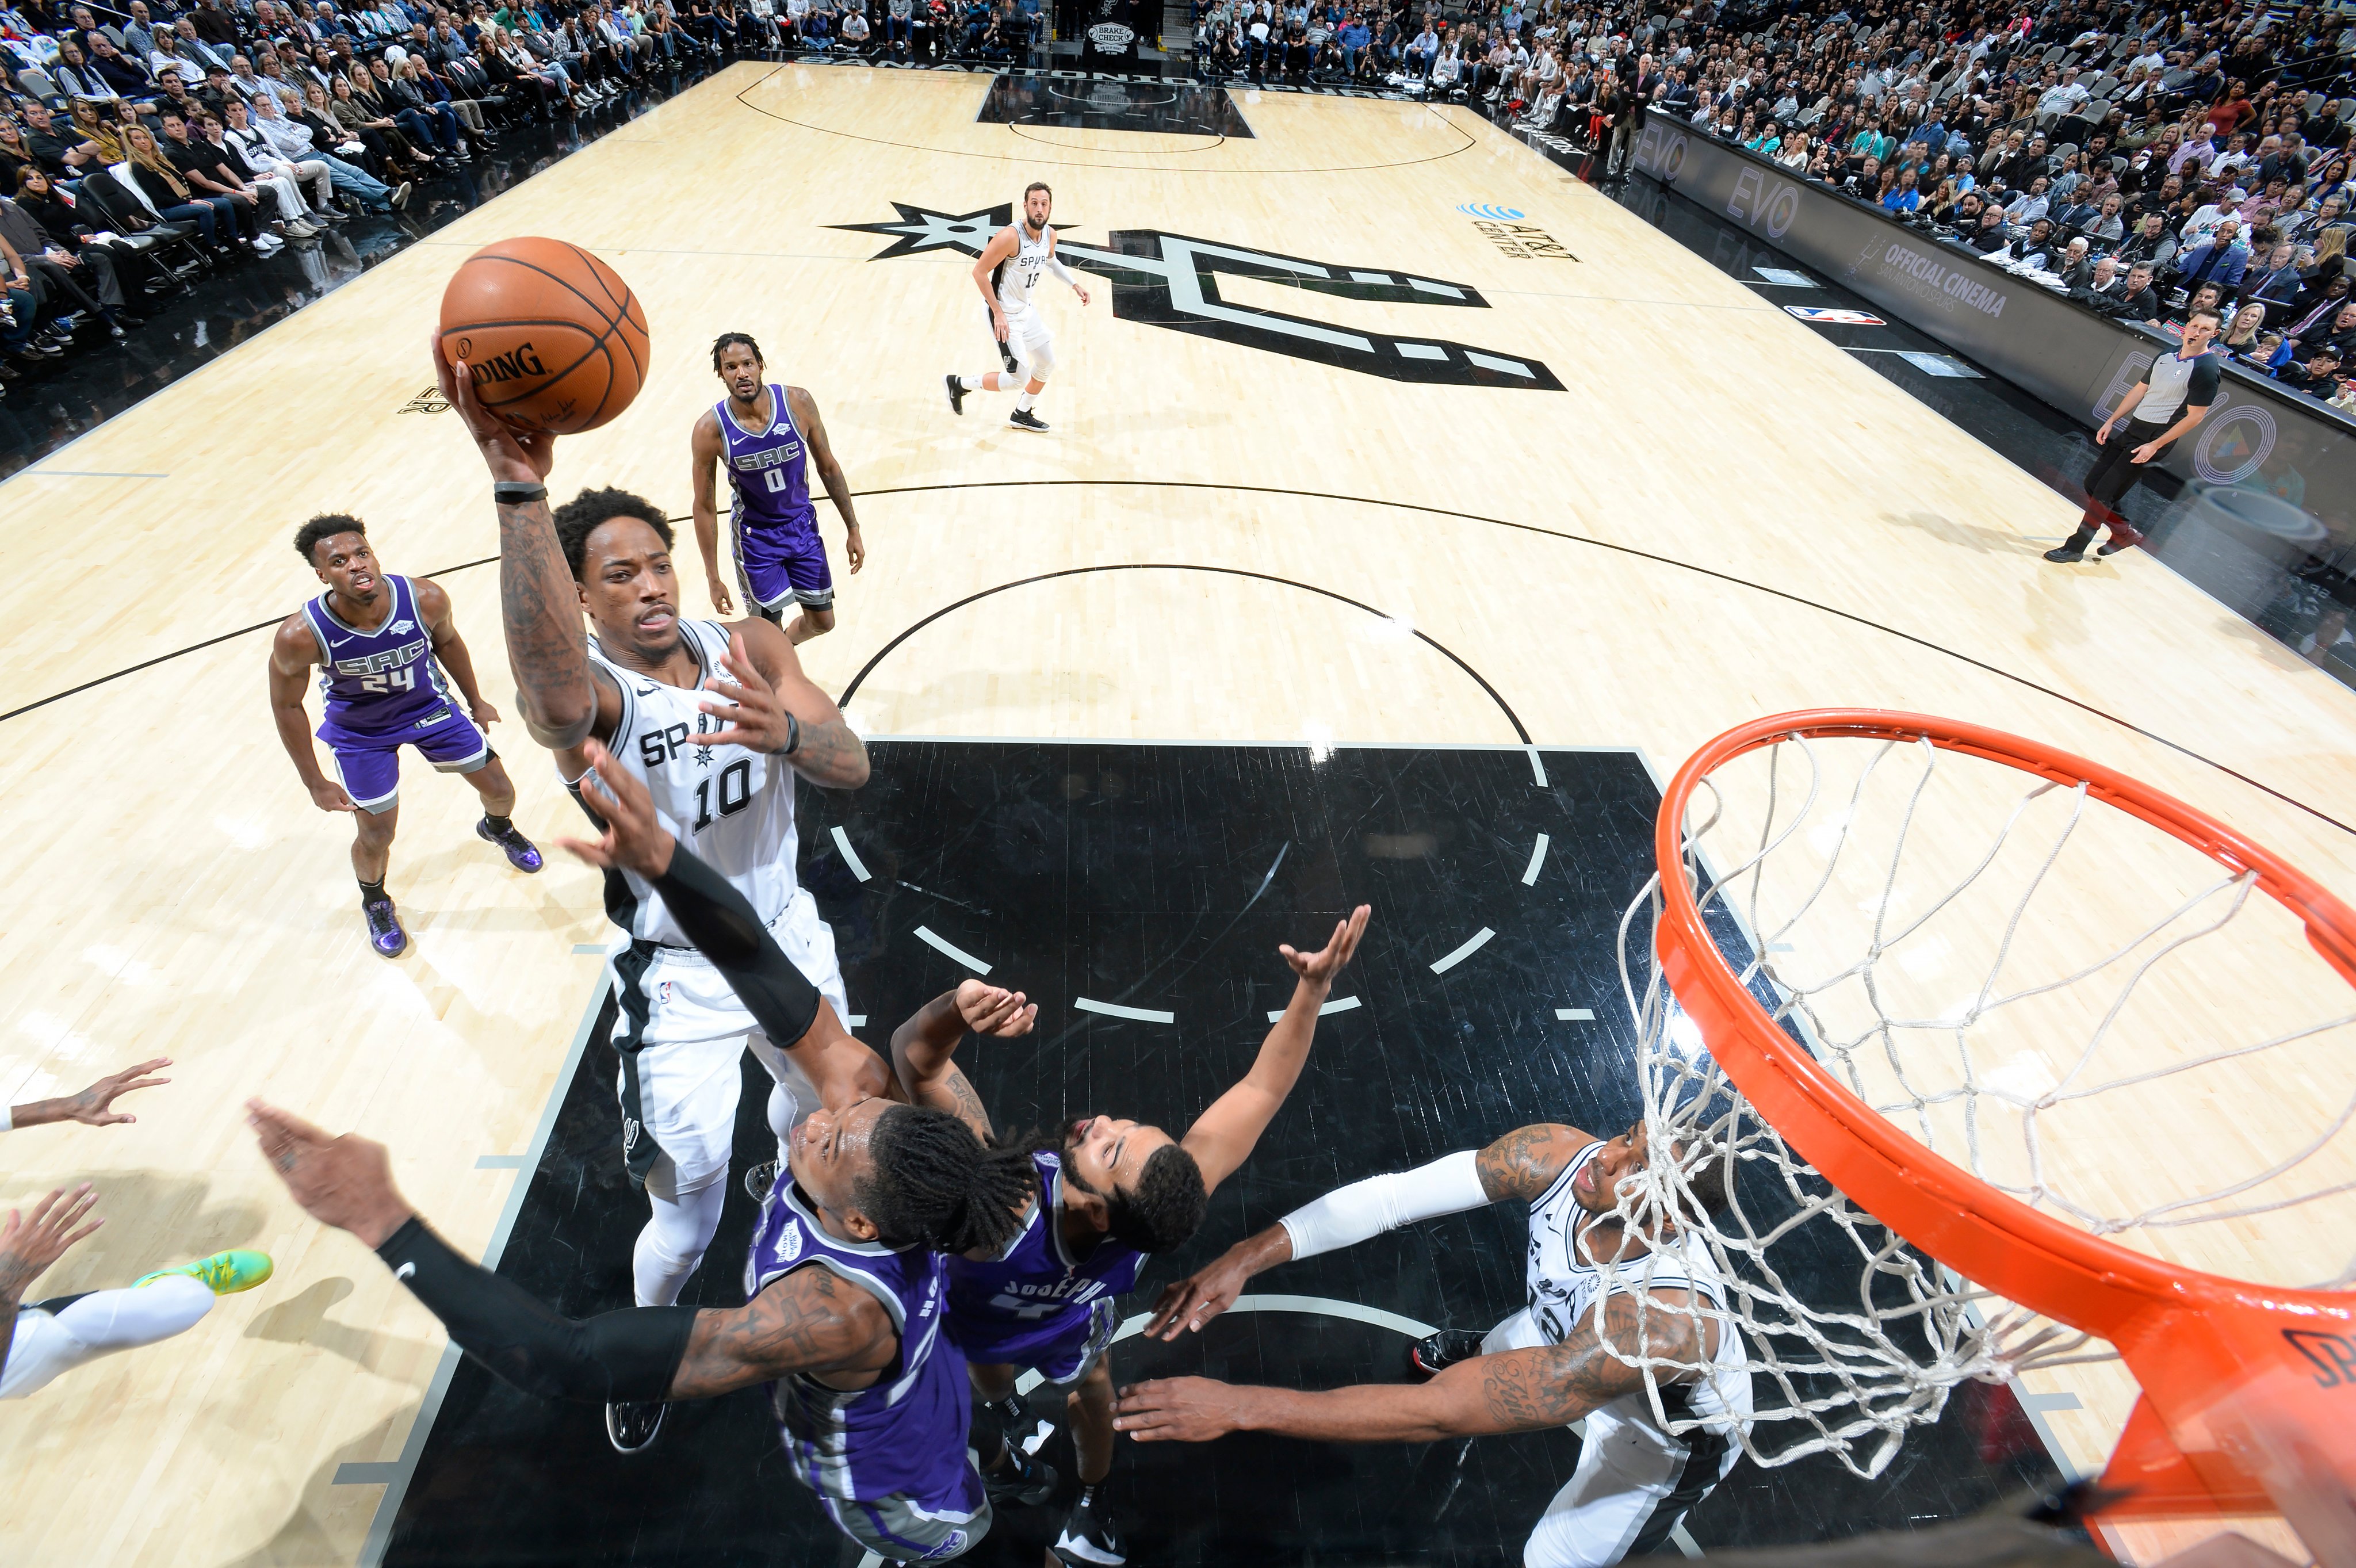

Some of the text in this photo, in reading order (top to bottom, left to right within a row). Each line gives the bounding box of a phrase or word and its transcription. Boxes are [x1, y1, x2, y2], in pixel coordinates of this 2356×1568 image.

[793, 56, 1416, 102] SAN ANTONIO SPURS
[248, 143, 269, 156] SPUR
[1635, 121, 1689, 180] EVO
[1727, 166, 1799, 238] EVO
[1471, 220, 1534, 259] CENTER
[1500, 222, 1584, 263] AT&T
[1876, 263, 1957, 312] SAN ANTONIO SPURS
[1884, 244, 2007, 318] OFFICIAL CINEMA
[471, 342, 546, 387] DING
[734, 441, 800, 471] SAC
[764, 468, 786, 493] 0
[335, 638, 424, 675] SAC
[360, 666, 415, 694] 24
[692, 756, 754, 836] 10
[2280, 1328, 2356, 1389] SP
